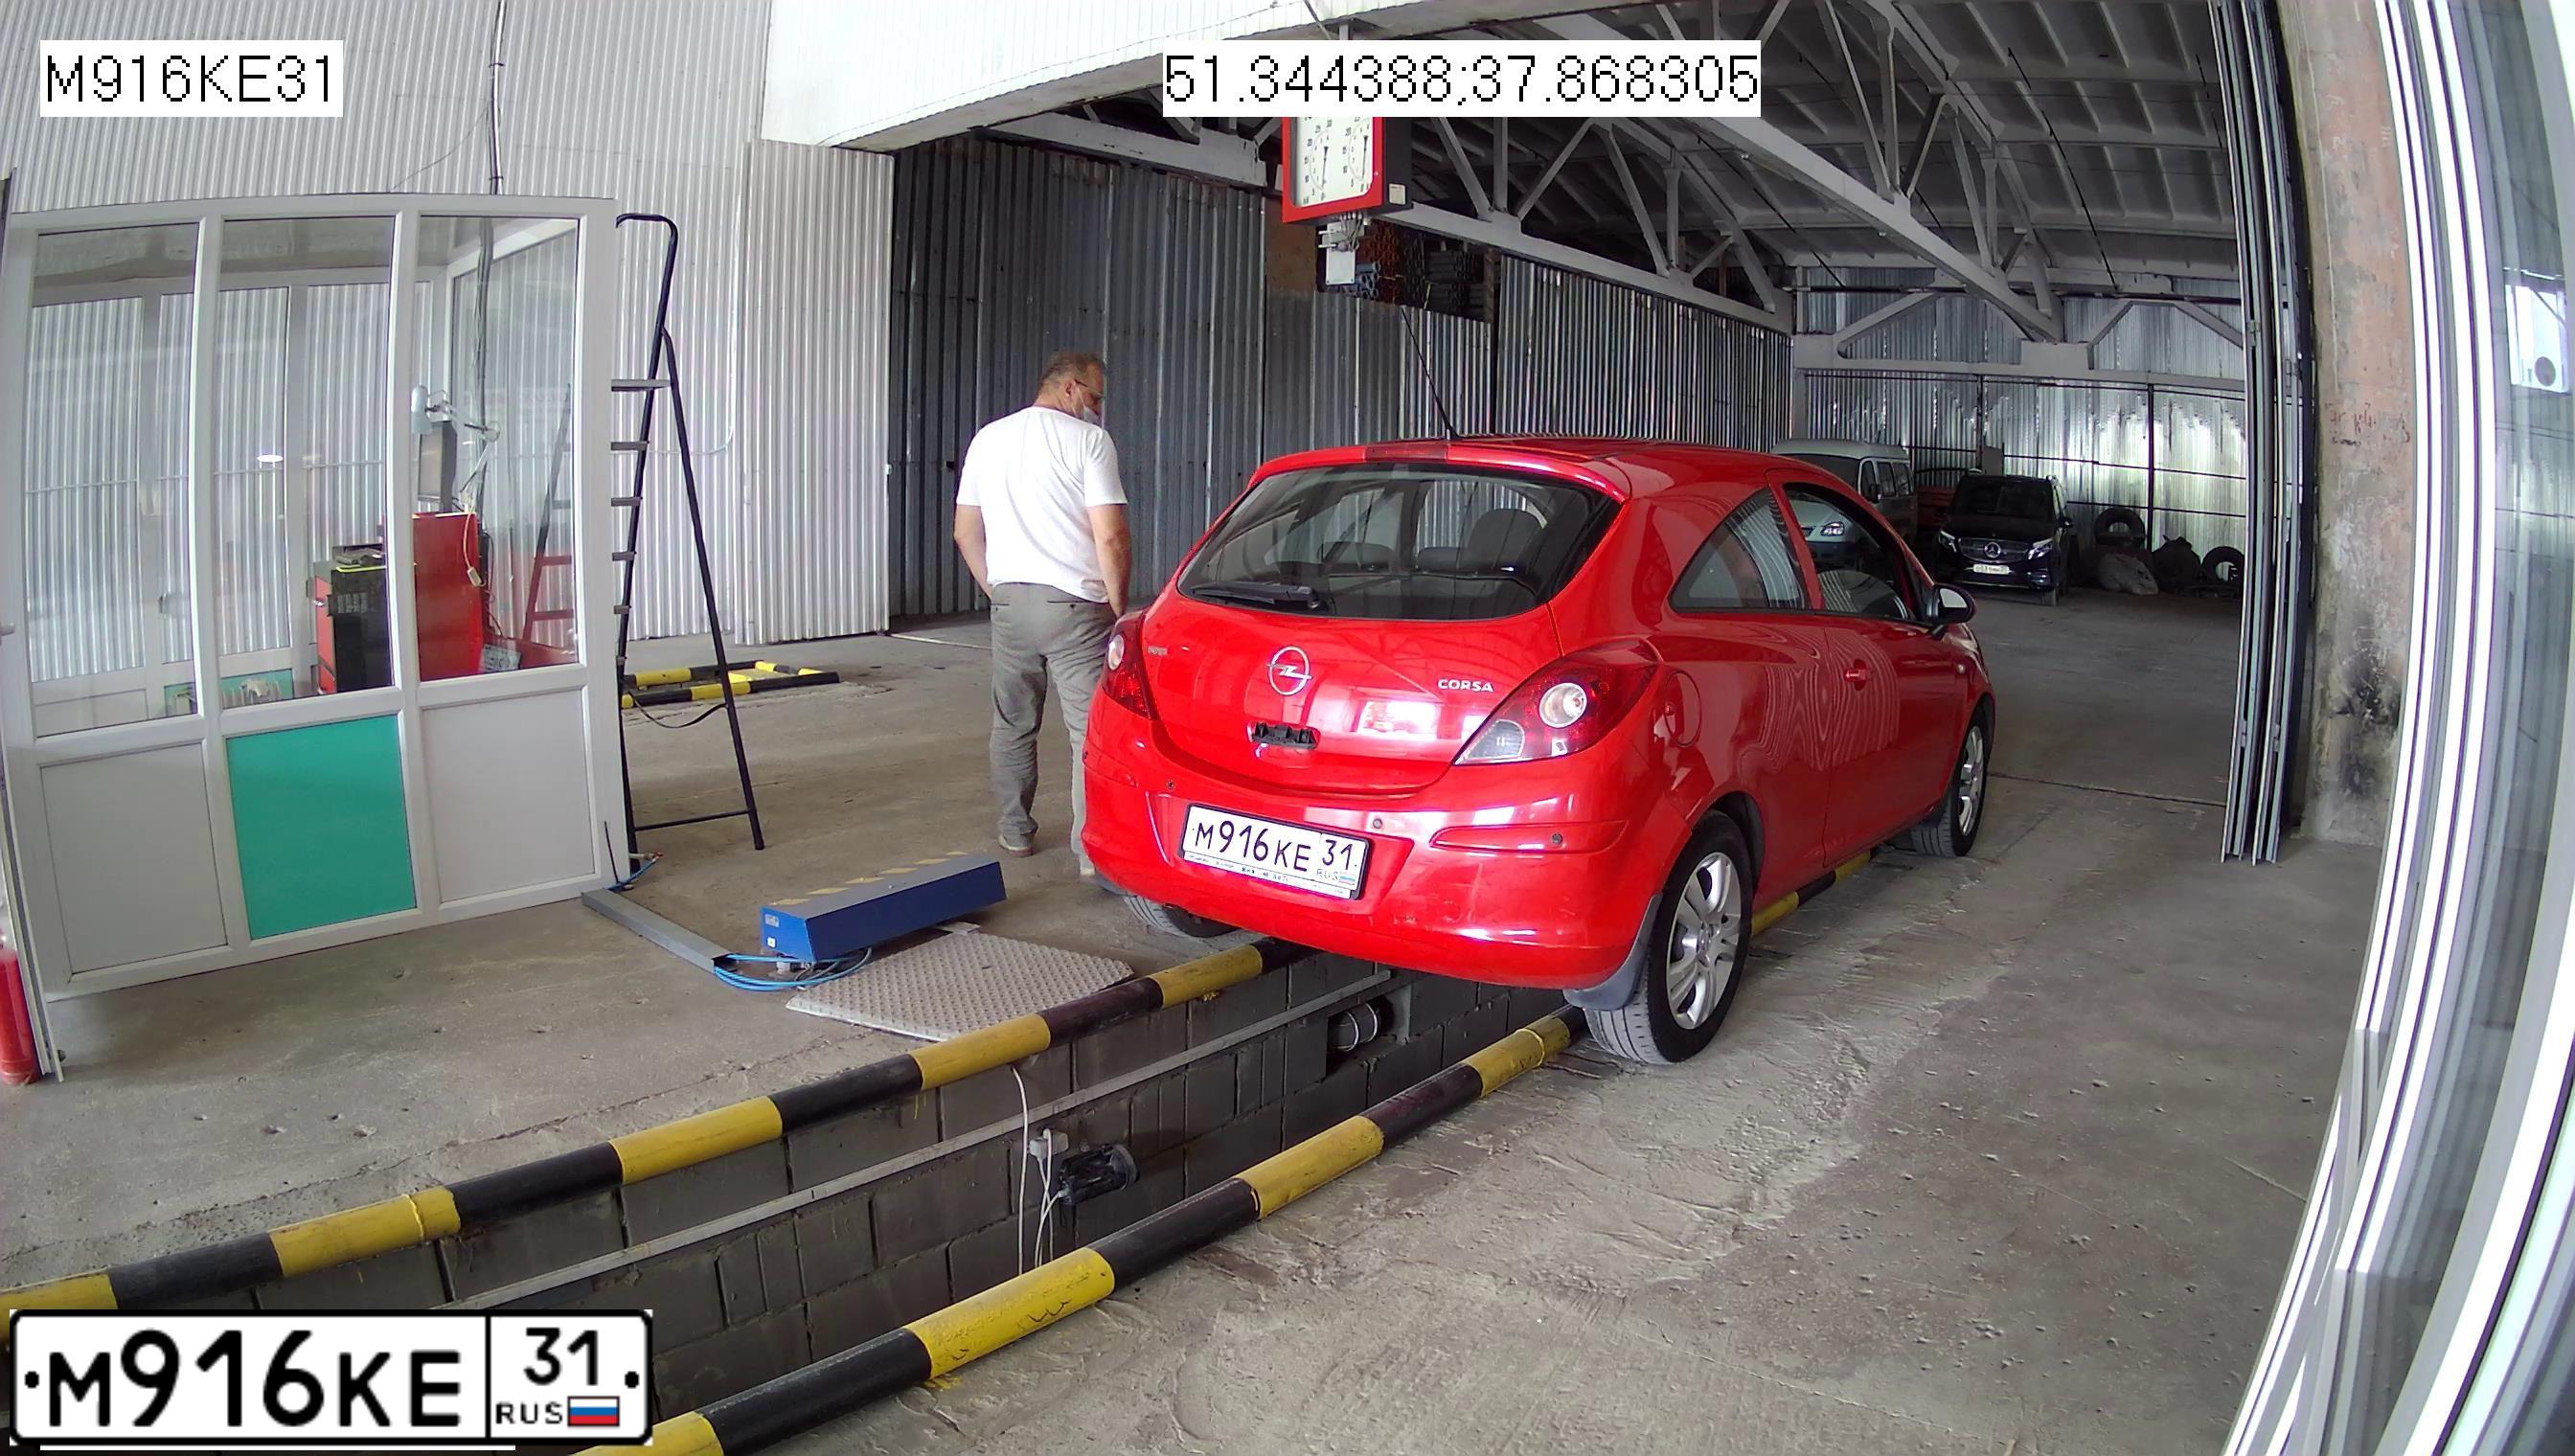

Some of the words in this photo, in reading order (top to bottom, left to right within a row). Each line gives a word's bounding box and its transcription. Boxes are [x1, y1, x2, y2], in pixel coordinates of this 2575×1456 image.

[1437, 678, 1493, 693] CORSA
[1195, 820, 1311, 873] M916KE
[1321, 838, 1353, 871] 31
[1315, 868, 1339, 881] RUS
